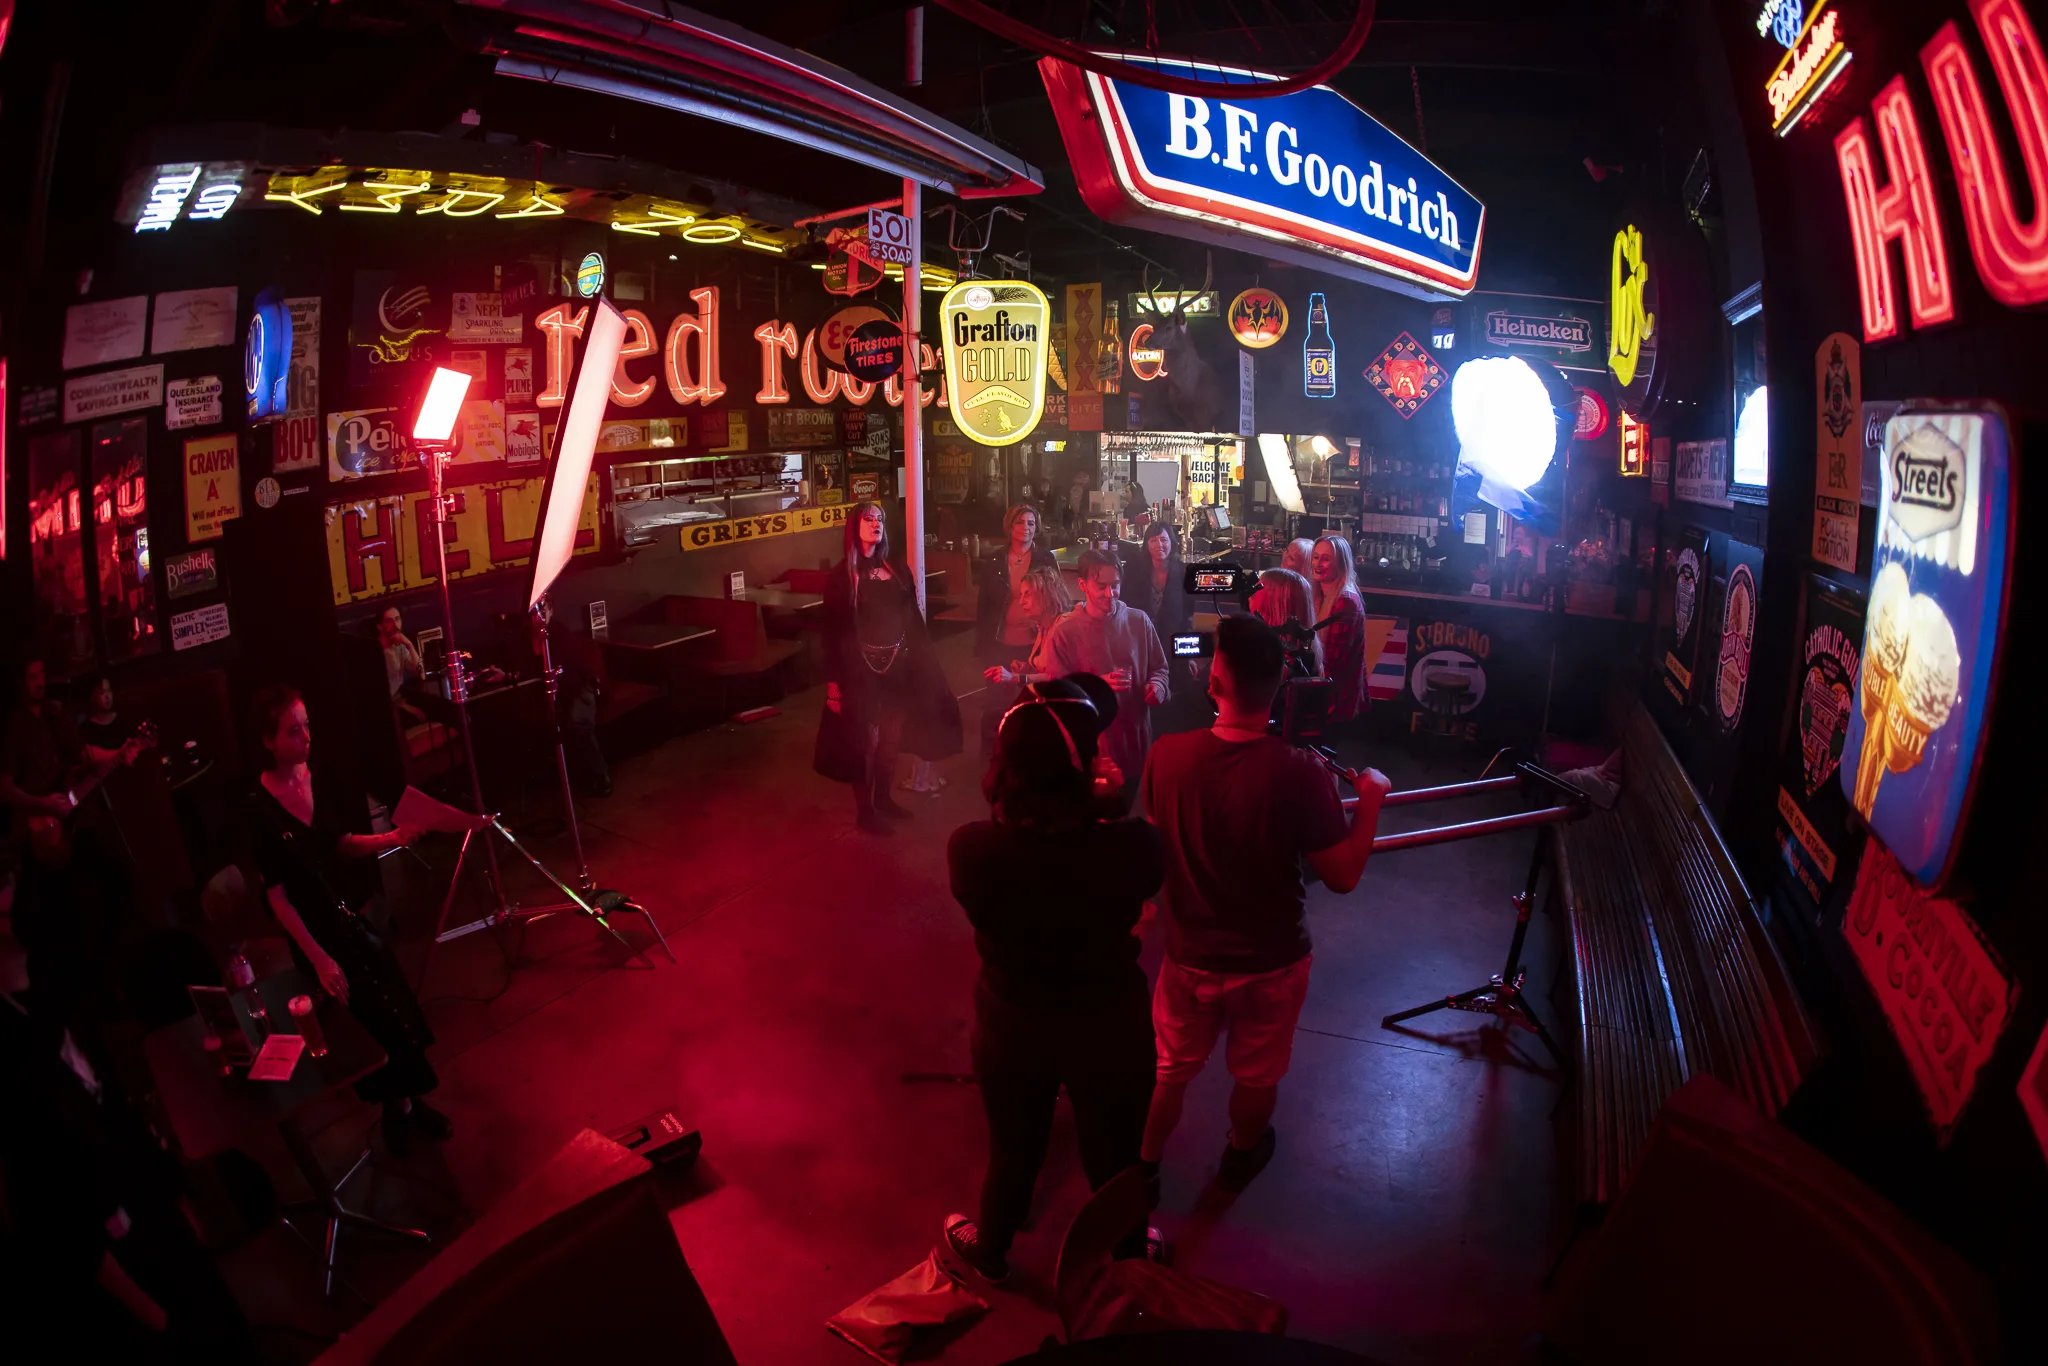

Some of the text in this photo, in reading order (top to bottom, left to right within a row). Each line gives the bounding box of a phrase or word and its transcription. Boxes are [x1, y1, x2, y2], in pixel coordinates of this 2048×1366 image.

[1265, 121, 1461, 251] Goodrich
[871, 209, 910, 247] 501
[881, 244, 912, 264] SOAP
[475, 303, 502, 317] NEPT
[465, 319, 503, 329] SPARKLING
[953, 310, 1037, 347] Grafton
[1494, 317, 1584, 342] Heineken
[536, 285, 727, 408] red
[849, 334, 904, 356] Firestone
[856, 352, 894, 367] TIRES
[961, 347, 1031, 383] GOLD
[70, 375, 158, 400] COMMONWEALTH
[170, 384, 220, 398] QUEENSLAND
[506, 379, 531, 393] PLUME
[77, 395, 119, 413] SAVINGS
[122, 390, 149, 404] BANK
[175, 395, 213, 407] INSURANCE
[1045, 404, 1066, 413] IVE
[1046, 395, 1066, 404] RK
[1071, 404, 1100, 413] LITE
[797, 413, 834, 425] BROWN
[275, 418, 316, 465] BOY
[507, 444, 540, 460] Mobilgas
[189, 448, 235, 475] CRAVEN
[355, 452, 380, 469] ice
[1191, 460, 1231, 473] ELCOME
[1892, 451, 1958, 511] Streets
[691, 506, 853, 546] GREYS is GRE
[1820, 516, 1850, 542] POLICE
[1818, 537, 1850, 563] STATION
[166, 552, 217, 592] Bushells
[172, 612, 196, 625] BALTIC
[174, 622, 205, 640] SIMPLEX
[1433, 621, 1491, 659] BRUNO
[1863, 655, 1928, 755] OUBLE BEAUTY
